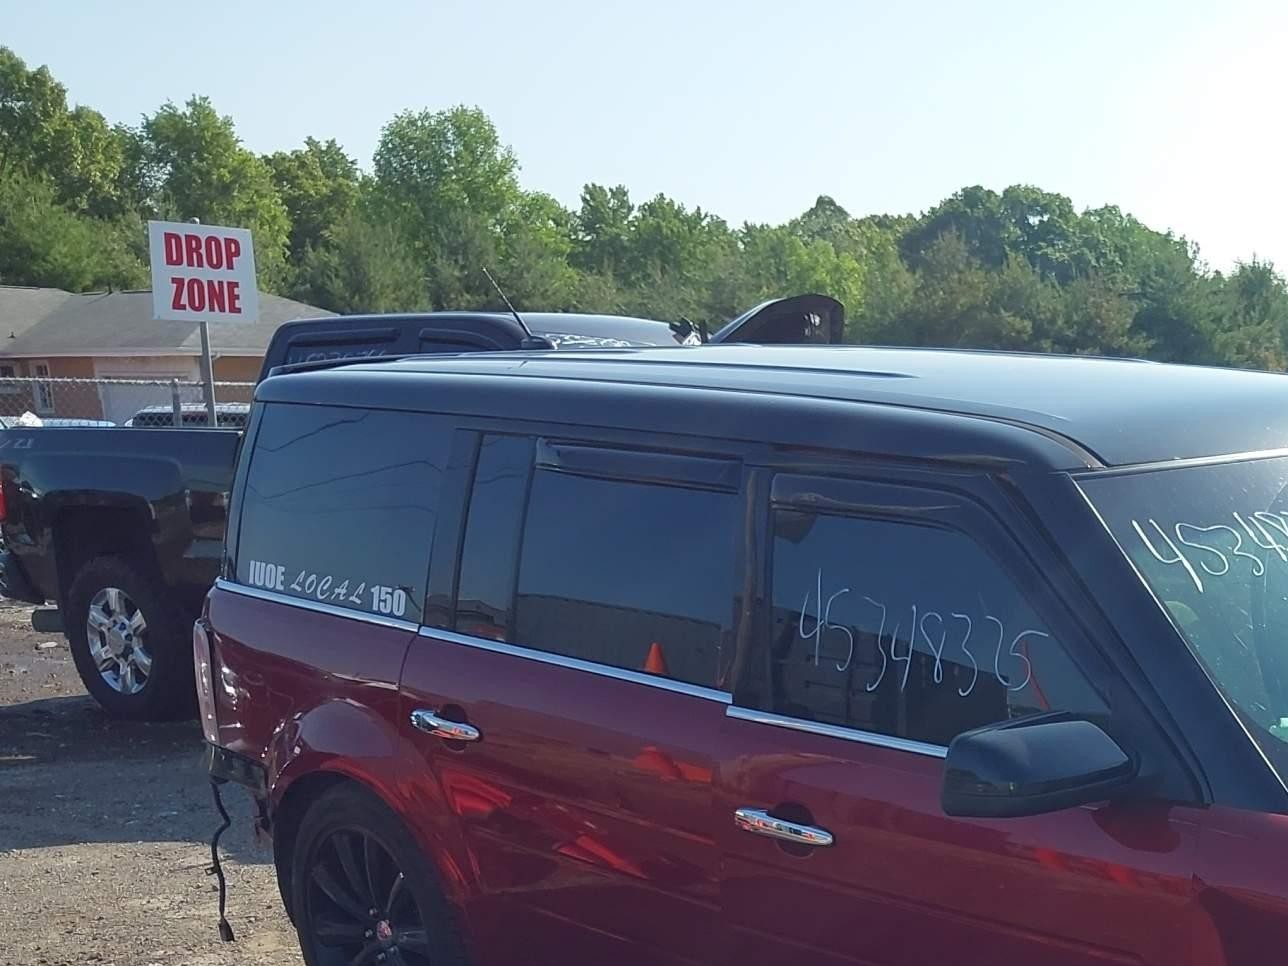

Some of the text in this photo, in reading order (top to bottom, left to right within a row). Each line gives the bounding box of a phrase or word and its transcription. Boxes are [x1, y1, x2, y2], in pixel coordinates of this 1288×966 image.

[163, 231, 241, 271] DROP
[170, 277, 242, 314] ZONE
[248, 560, 407, 617] IUOE LOCAL 150
